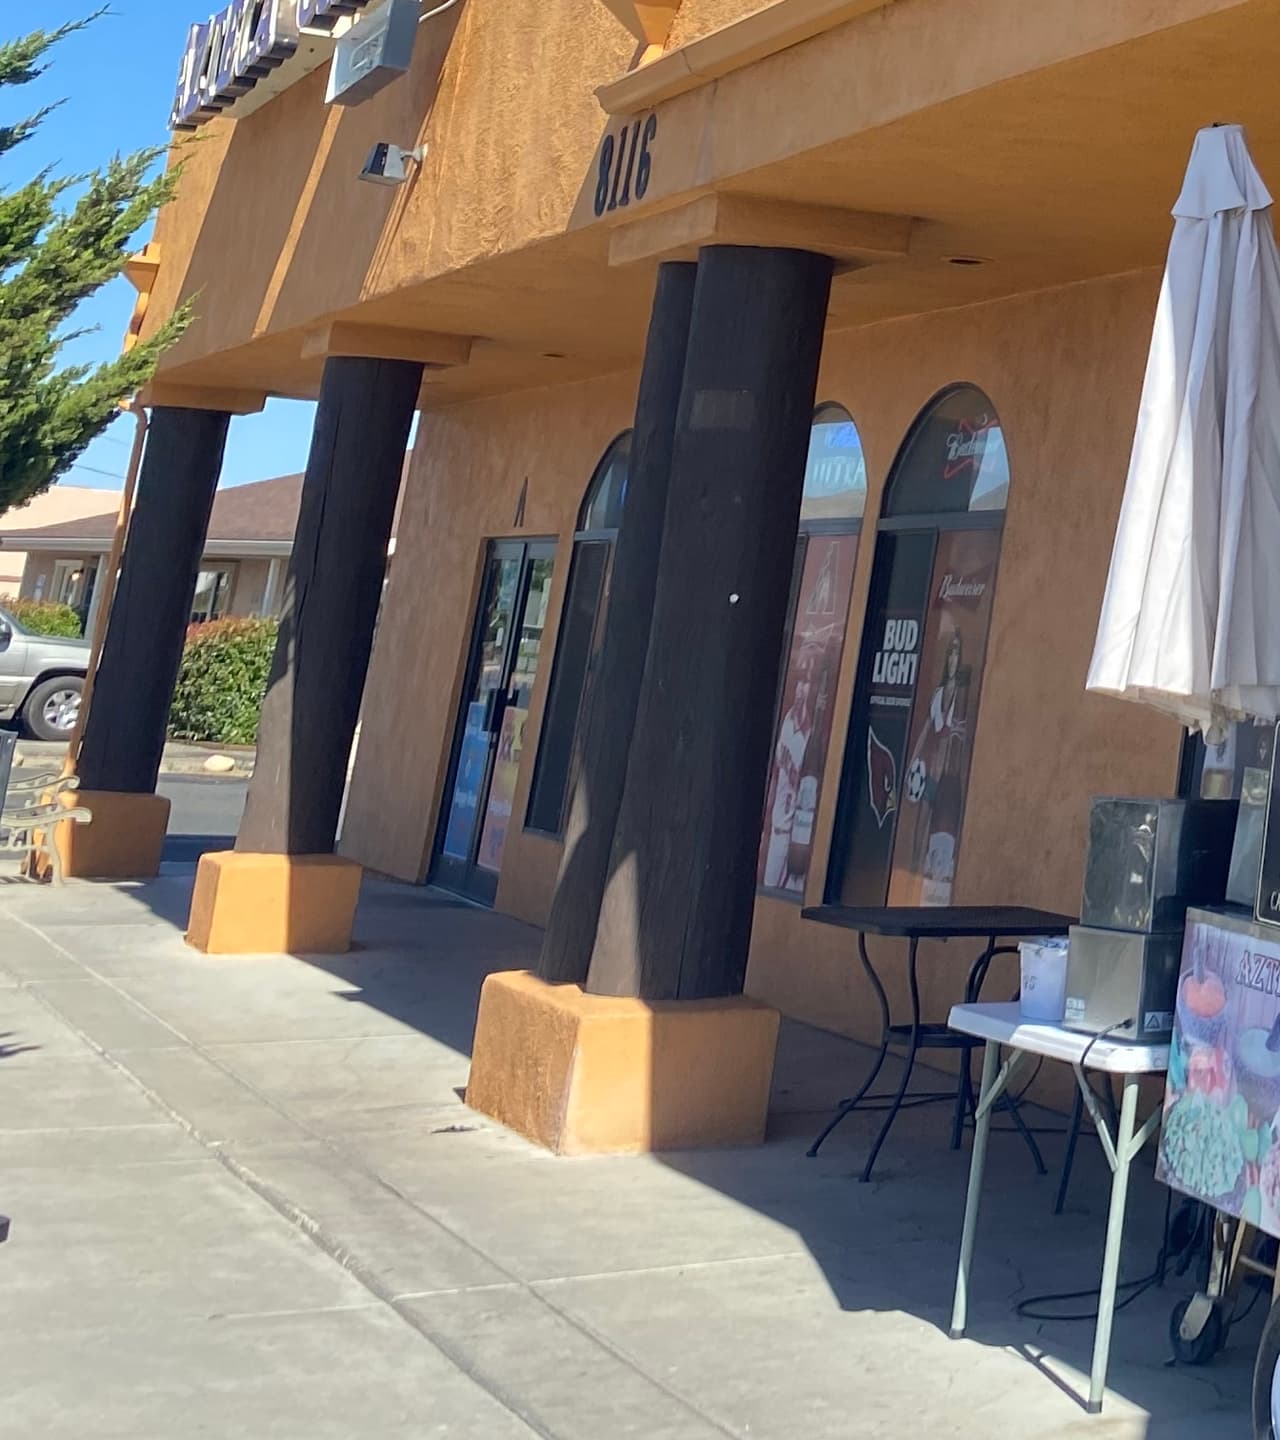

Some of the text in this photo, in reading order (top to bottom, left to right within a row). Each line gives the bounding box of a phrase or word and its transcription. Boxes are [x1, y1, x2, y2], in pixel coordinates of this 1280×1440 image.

[594, 112, 657, 217] 8116
[883, 619, 919, 651] BUD
[872, 652, 918, 685] LIGHT
